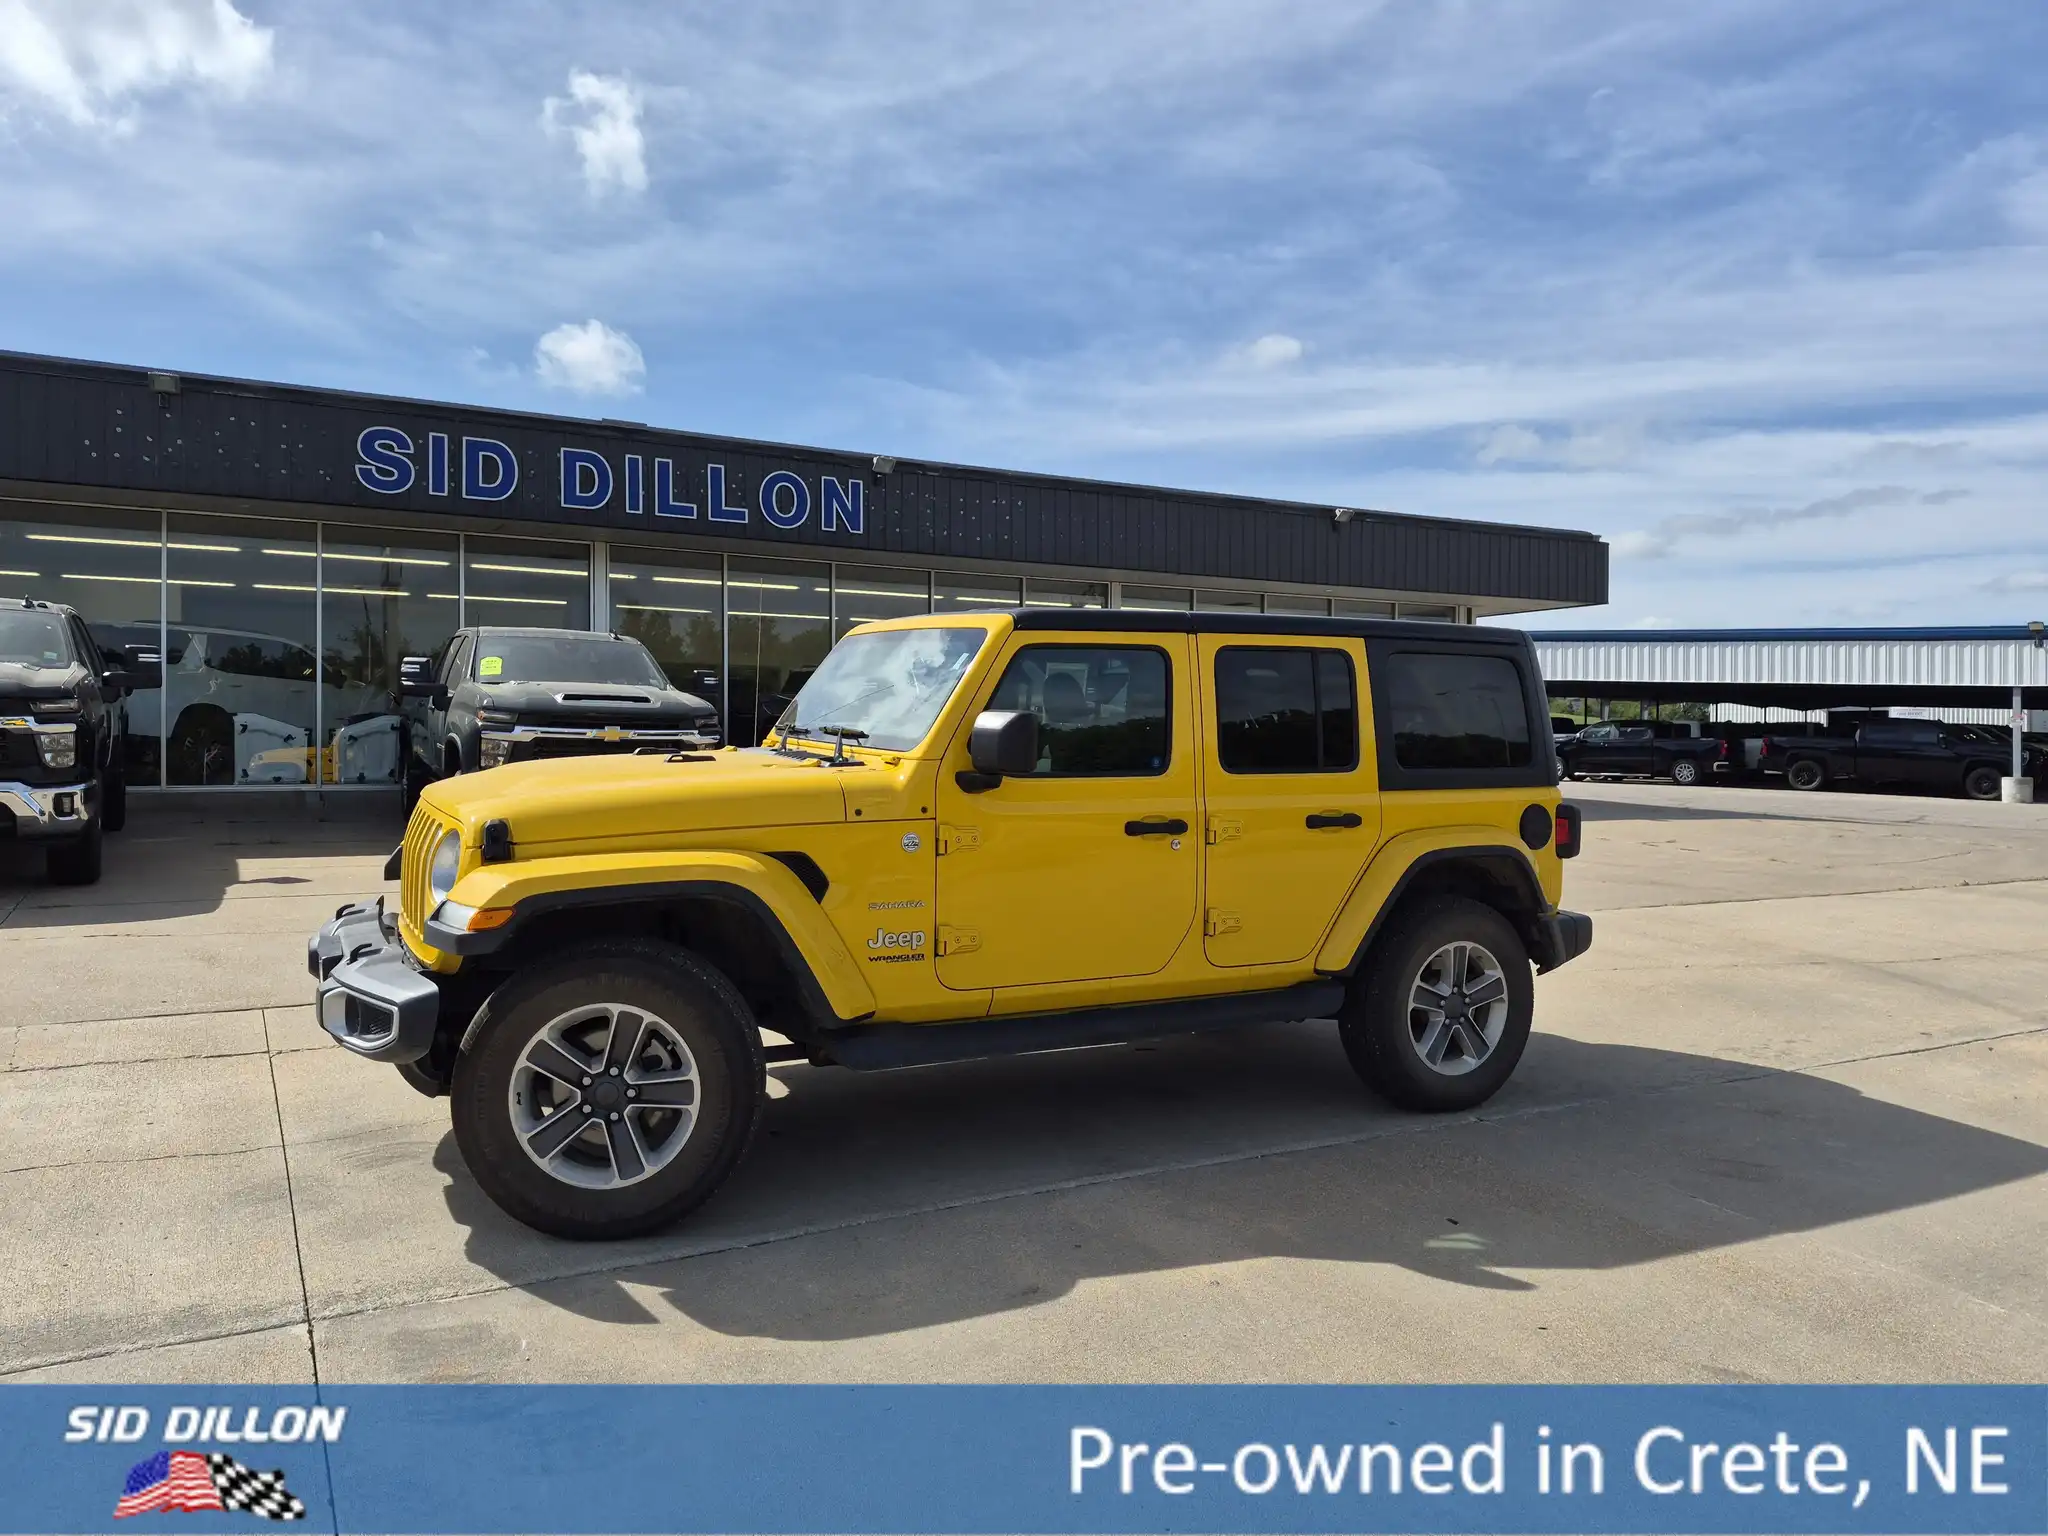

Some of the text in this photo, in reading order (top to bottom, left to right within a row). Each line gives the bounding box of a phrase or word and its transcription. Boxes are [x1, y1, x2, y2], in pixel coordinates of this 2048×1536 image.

[355, 426, 864, 534] SID DILLON
[868, 900, 925, 910] SAHARA
[867, 928, 925, 950] Jeep
[868, 953, 925, 962] WRANGLER
